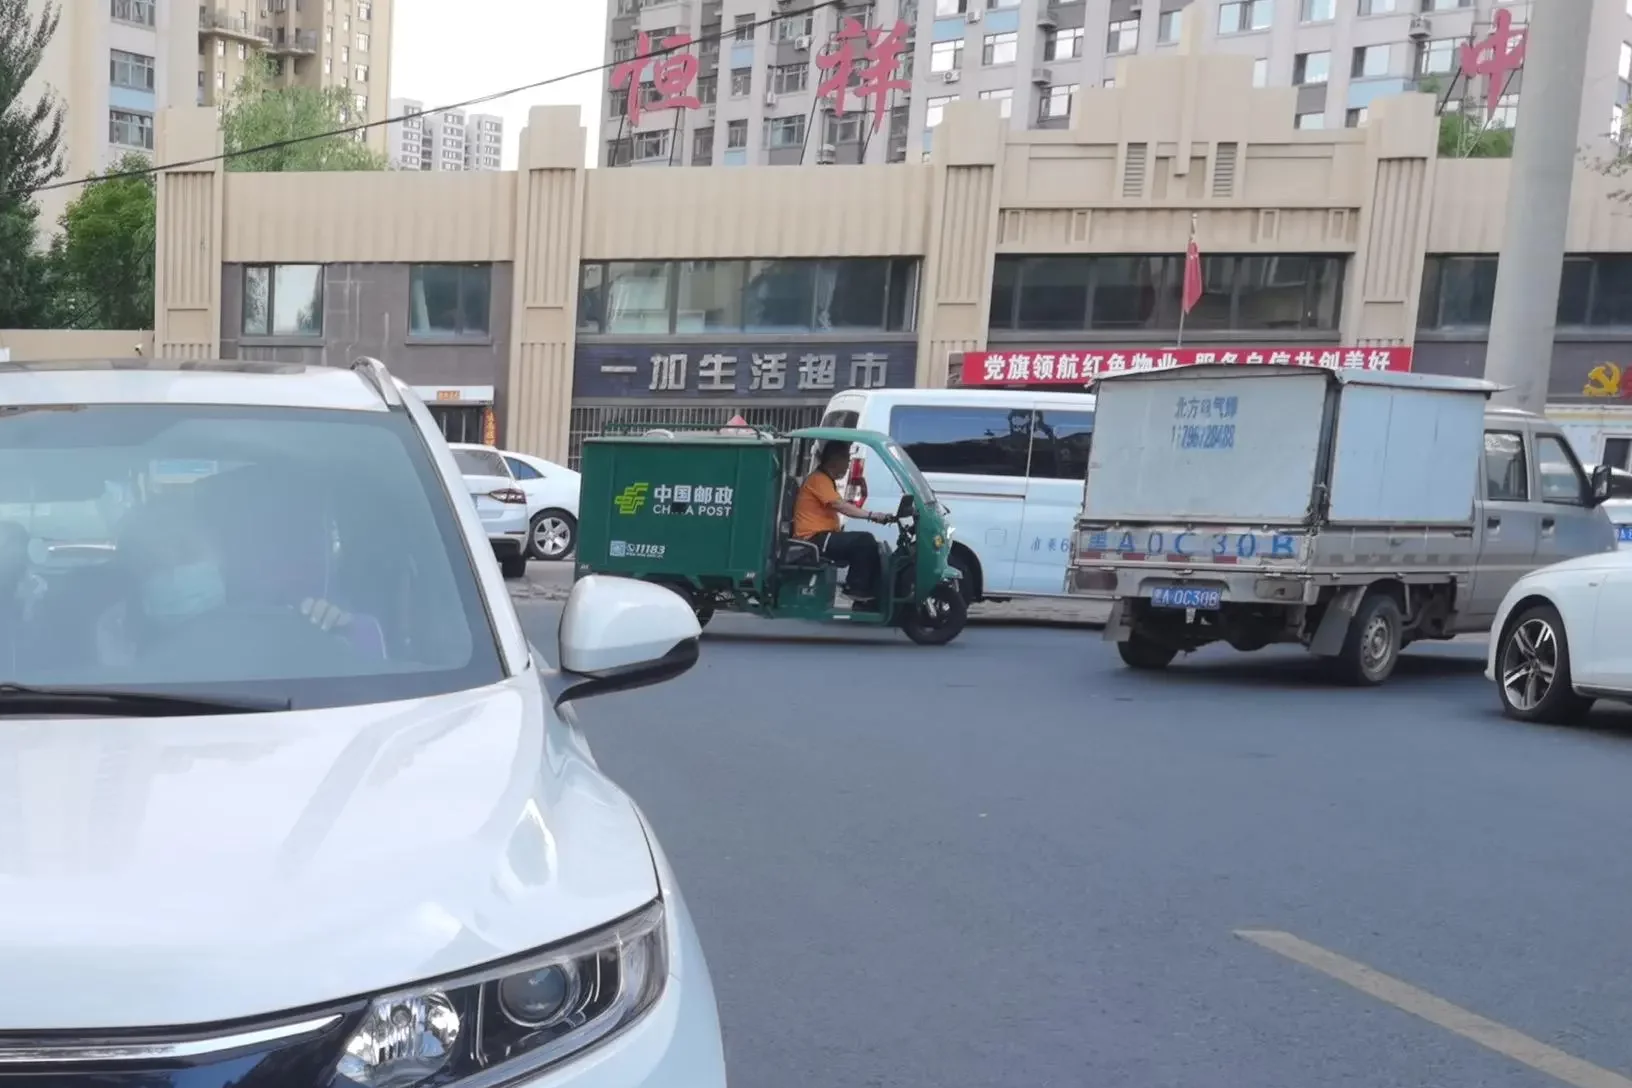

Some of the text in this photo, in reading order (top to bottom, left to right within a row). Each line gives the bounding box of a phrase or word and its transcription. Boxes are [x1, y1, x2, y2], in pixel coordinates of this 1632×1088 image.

[601, 352, 888, 391] 一加生活超市
[653, 484, 733, 505] 中国邮政
[653, 504, 732, 517] CHA POST
[635, 543, 666, 555] 11183
